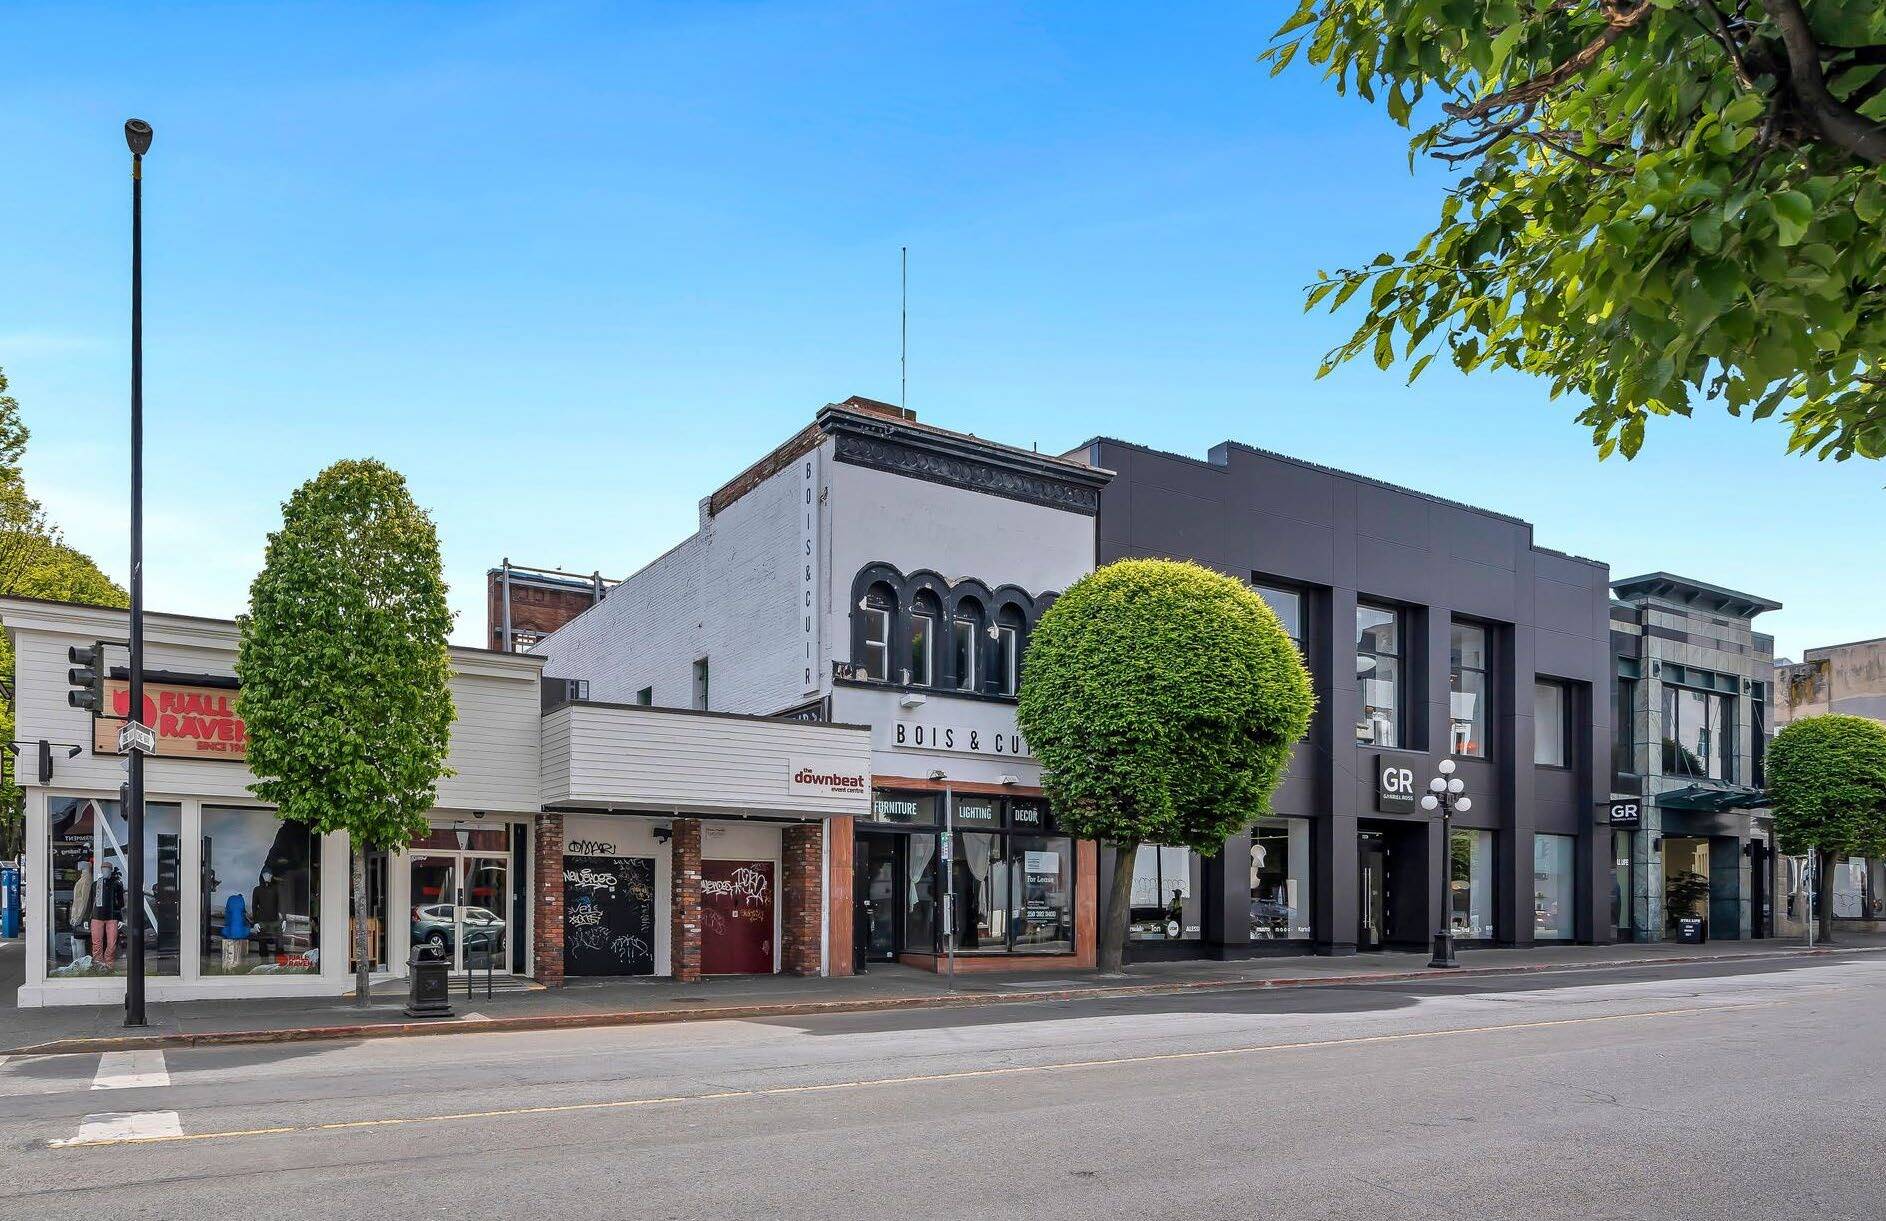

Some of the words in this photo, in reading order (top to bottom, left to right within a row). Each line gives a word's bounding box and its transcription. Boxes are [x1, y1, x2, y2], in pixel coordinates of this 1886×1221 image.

[197, 741, 227, 751] SINCE
[897, 724, 954, 748] BOIS
[970, 731, 980, 750] &
[995, 734, 1031, 756] CUI
[794, 771, 865, 788] downbeat
[1383, 767, 1414, 794] GR
[874, 801, 917, 815] FURNITURE
[959, 806, 992, 820] LIGHTING
[1611, 804, 1638, 818] GR
[1015, 809, 1039, 823] DECOR
[1027, 875, 1036, 883] For
[1037, 875, 1054, 883] Lease
